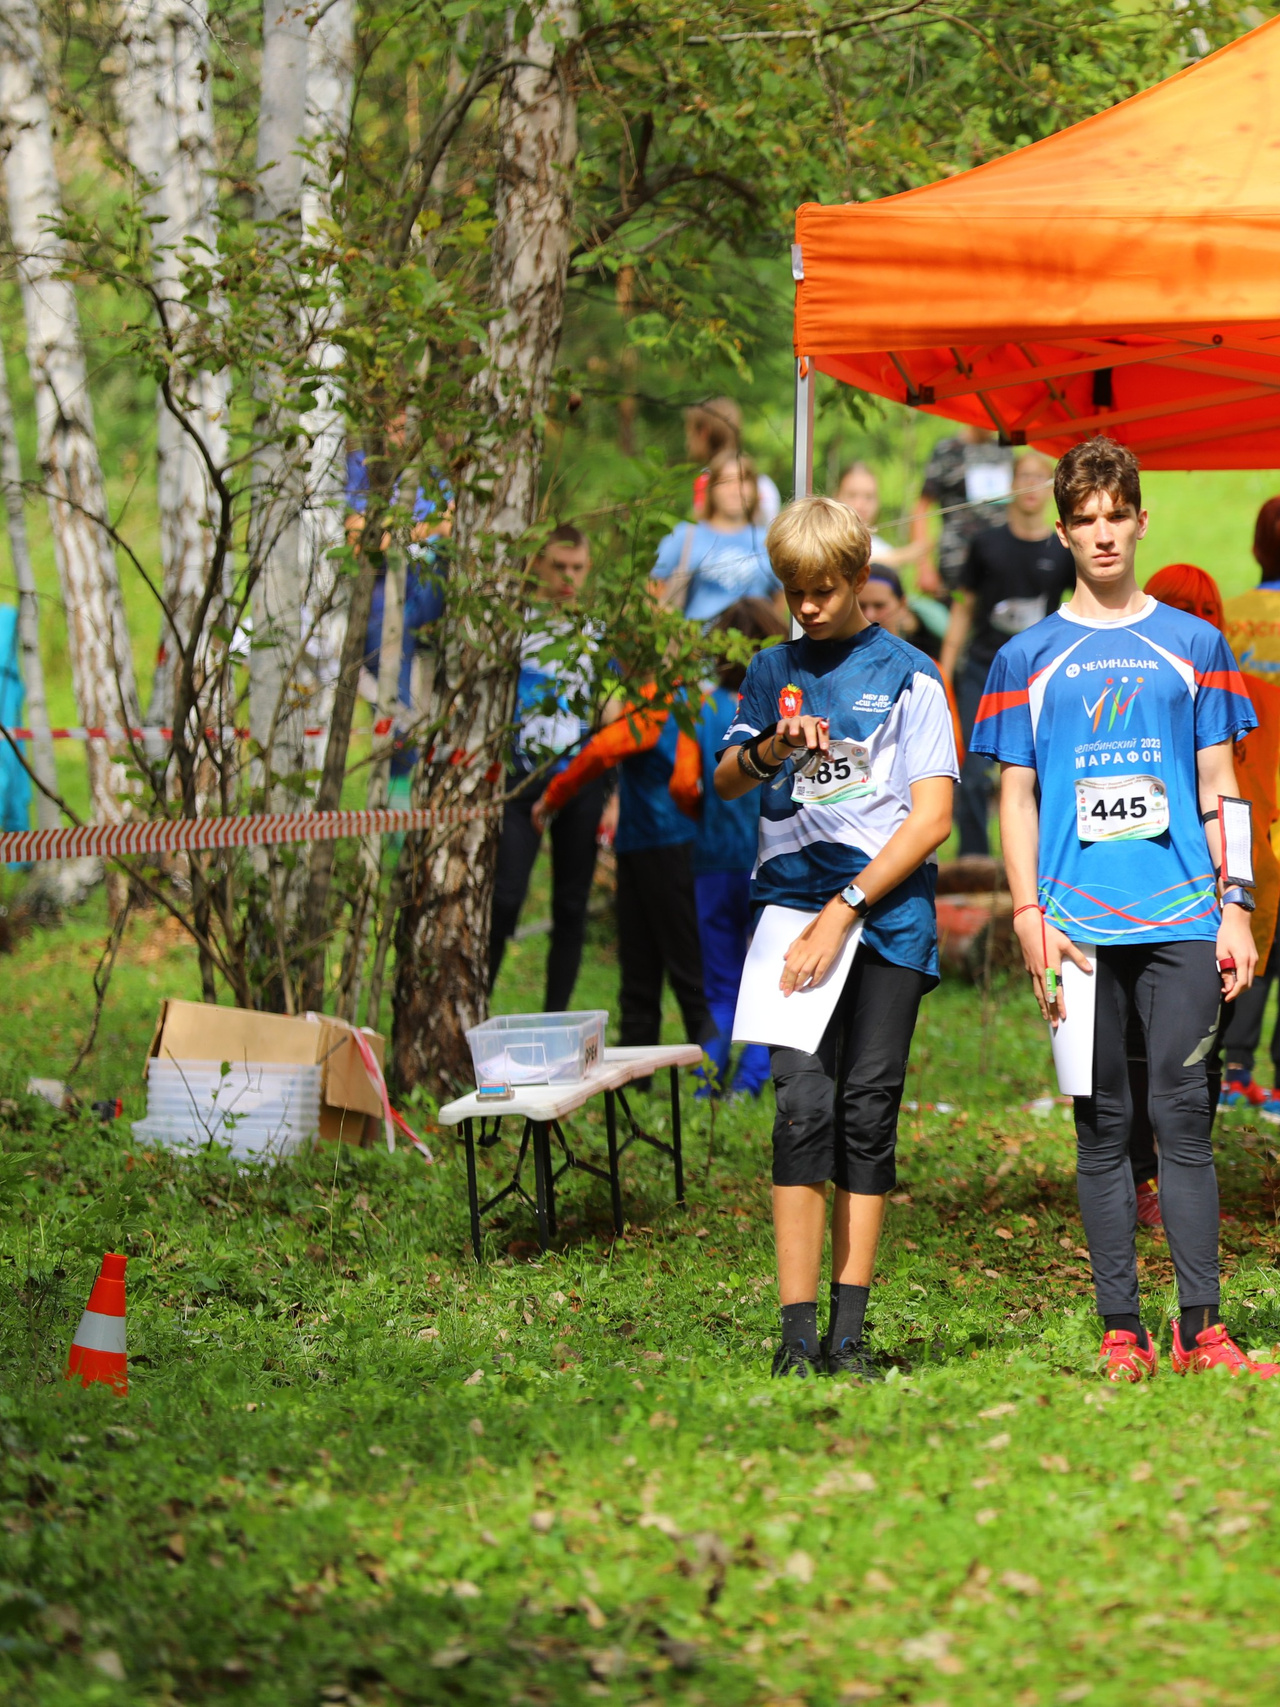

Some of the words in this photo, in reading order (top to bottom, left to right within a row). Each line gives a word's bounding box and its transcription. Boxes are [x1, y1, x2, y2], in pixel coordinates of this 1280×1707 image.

[1082, 658, 1159, 672] ЧЕЛИНДБАНК
[1140, 738, 1161, 749] 2023
[1075, 750, 1162, 769] МАРАФОН
[1091, 796, 1147, 820] 445
